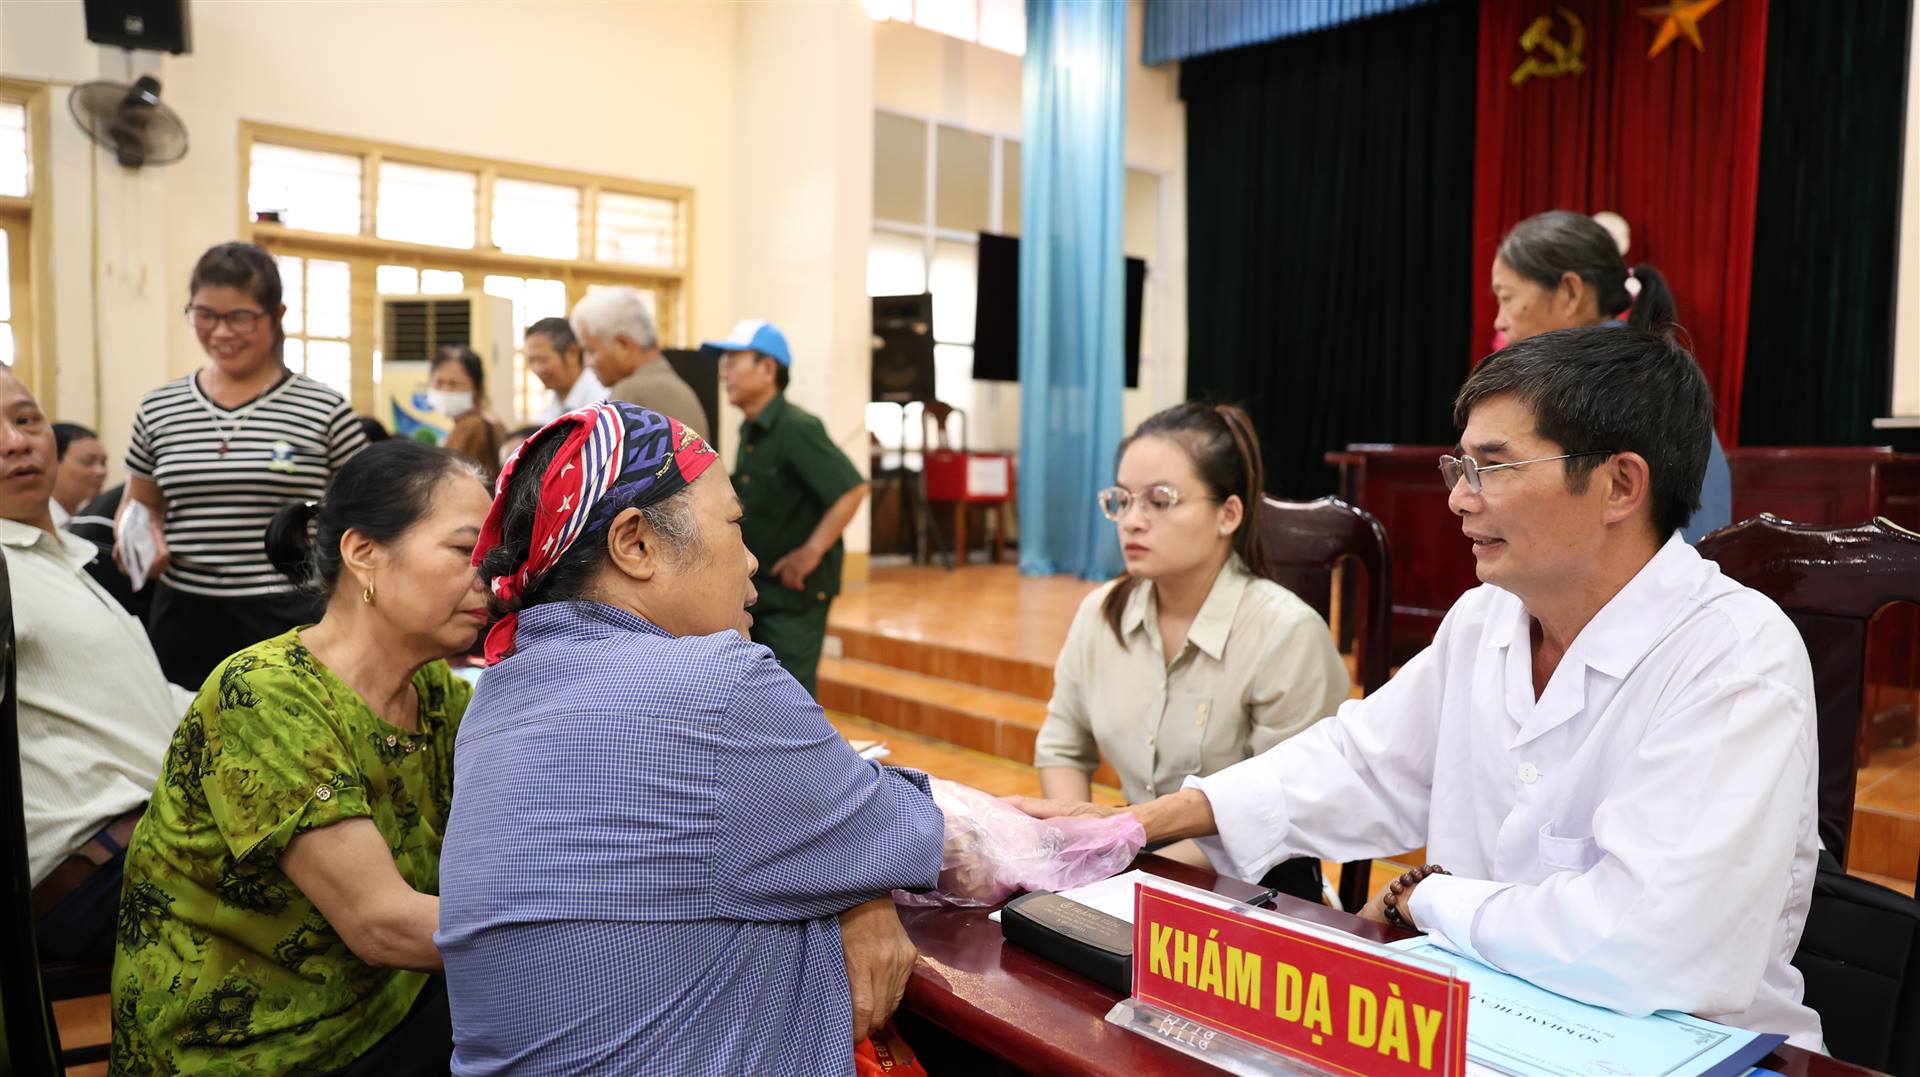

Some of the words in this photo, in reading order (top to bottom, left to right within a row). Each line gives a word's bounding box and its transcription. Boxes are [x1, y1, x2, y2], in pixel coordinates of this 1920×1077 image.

[1150, 922, 1261, 1010] KHÁM
[1275, 961, 1333, 1046] DẠ
[1347, 981, 1443, 1070] DÀY
